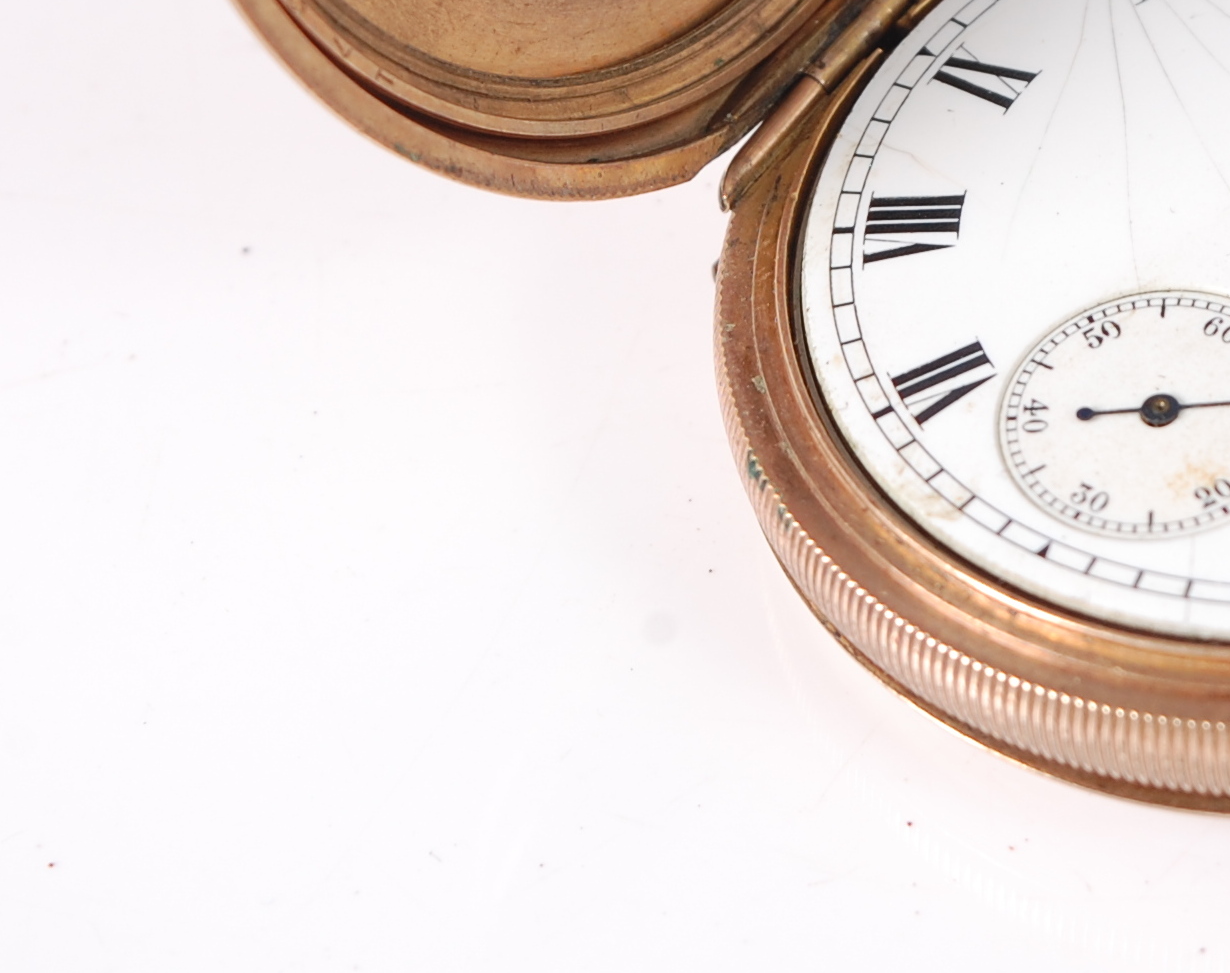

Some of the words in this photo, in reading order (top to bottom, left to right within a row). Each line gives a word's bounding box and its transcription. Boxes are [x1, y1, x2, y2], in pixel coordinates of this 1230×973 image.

[927, 43, 1042, 115] IX
[862, 189, 967, 269] VIII
[1081, 319, 1122, 350] 50
[887, 336, 998, 431] VII
[1021, 398, 1050, 435] 40
[1069, 482, 1111, 514] 30
